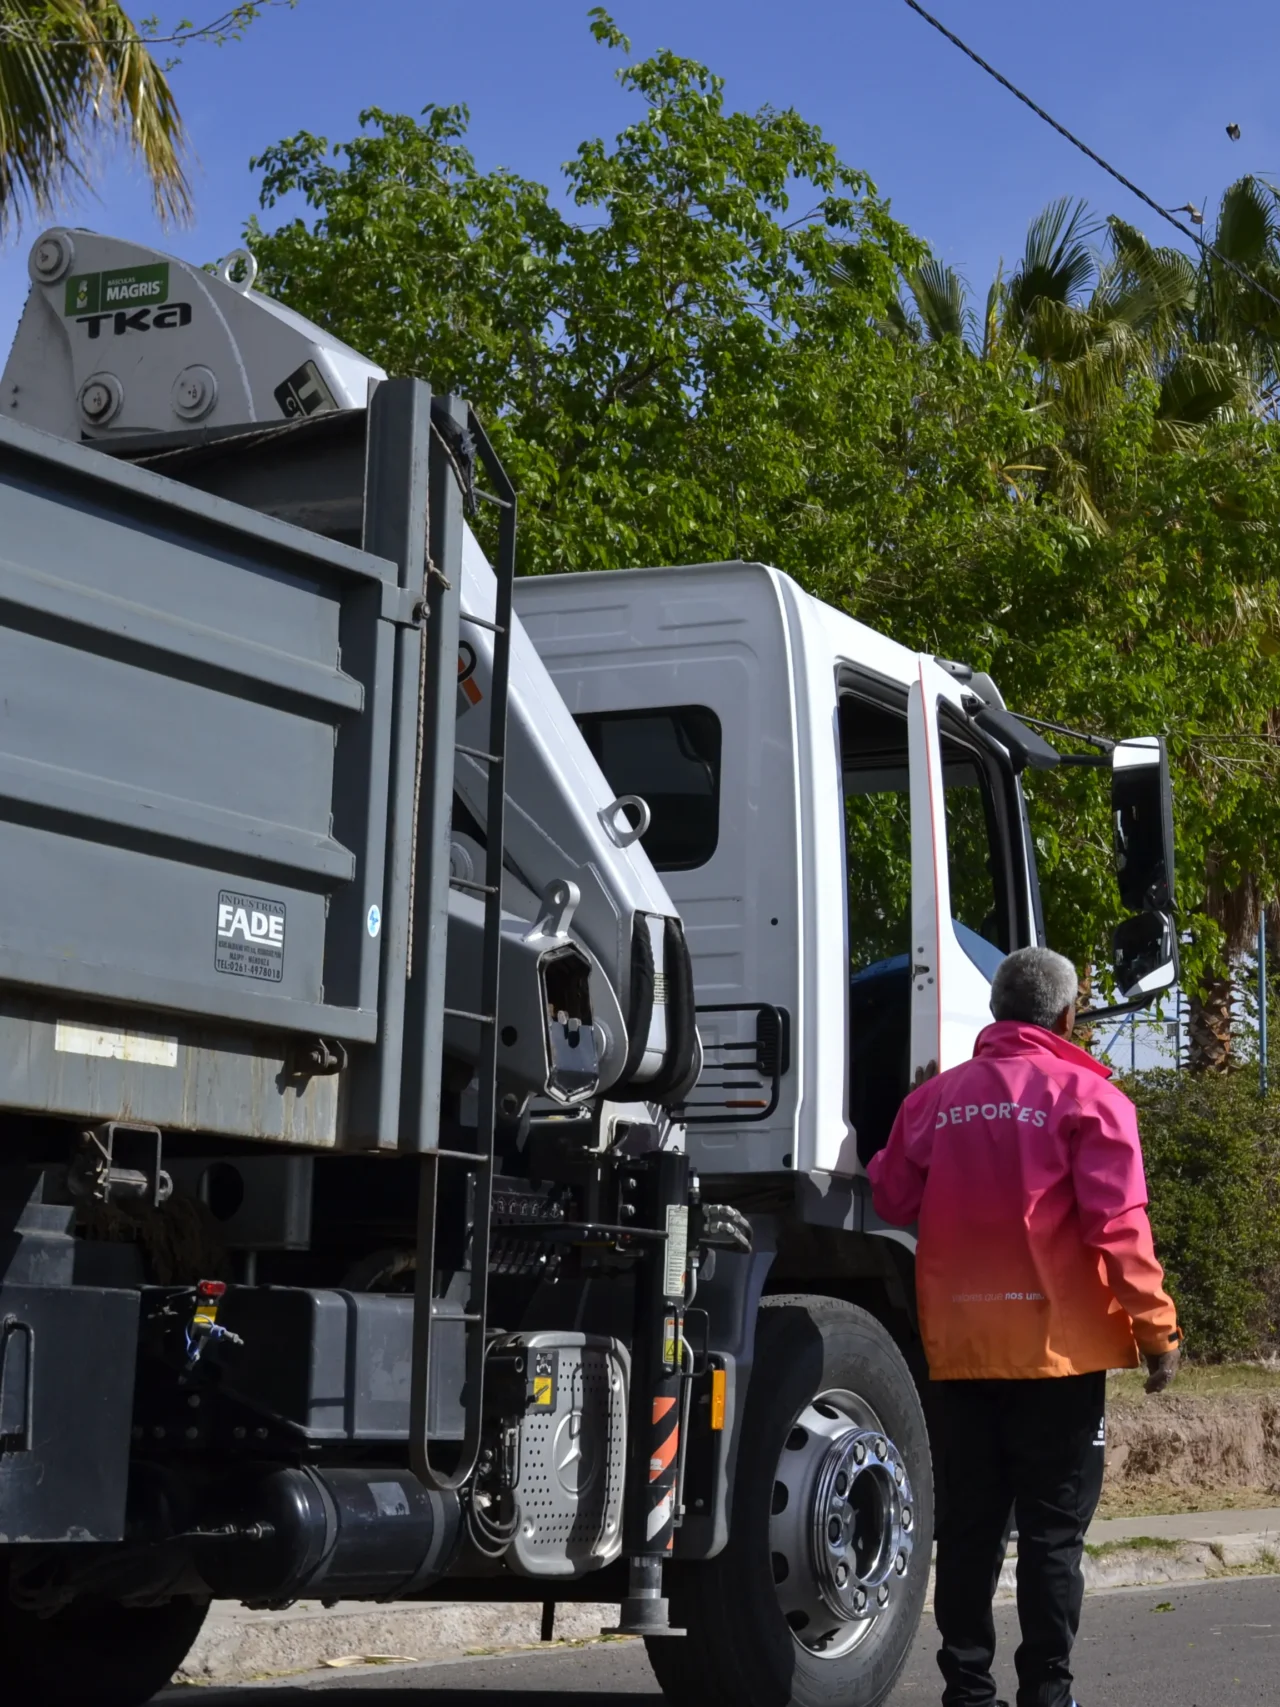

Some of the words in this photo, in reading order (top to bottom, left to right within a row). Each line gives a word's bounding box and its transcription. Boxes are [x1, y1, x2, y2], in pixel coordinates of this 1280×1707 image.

[106, 281, 161, 302] MAGRIS
[221, 894, 284, 914] INDUSTRIAS
[218, 904, 284, 942] FADE
[1005, 1292, 1023, 1301] nos
